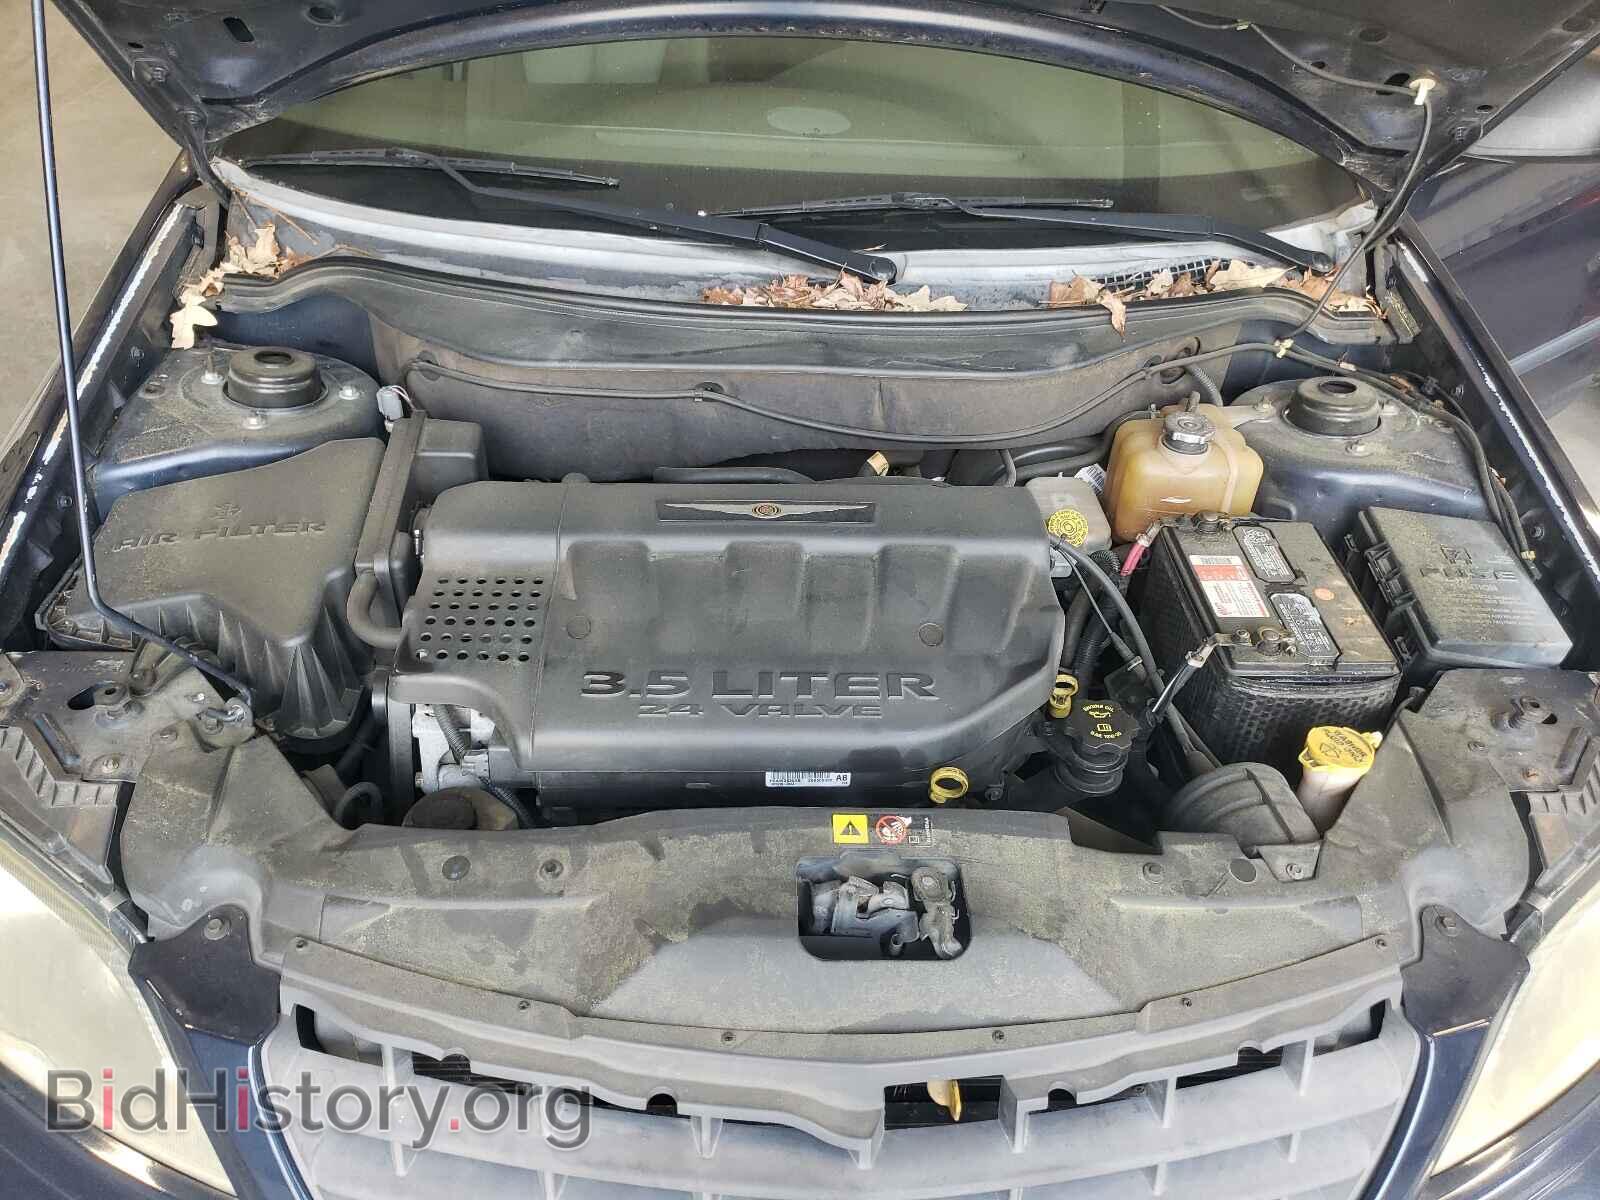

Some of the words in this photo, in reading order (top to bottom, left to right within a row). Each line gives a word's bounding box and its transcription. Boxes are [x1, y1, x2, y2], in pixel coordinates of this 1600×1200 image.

[112, 532, 179, 552] AIR
[193, 521, 327, 541] FILTER
[580, 670, 691, 699] 3.5
[711, 671, 941, 701] LITER
[637, 703, 704, 719] 24
[719, 703, 883, 719] VALVE
